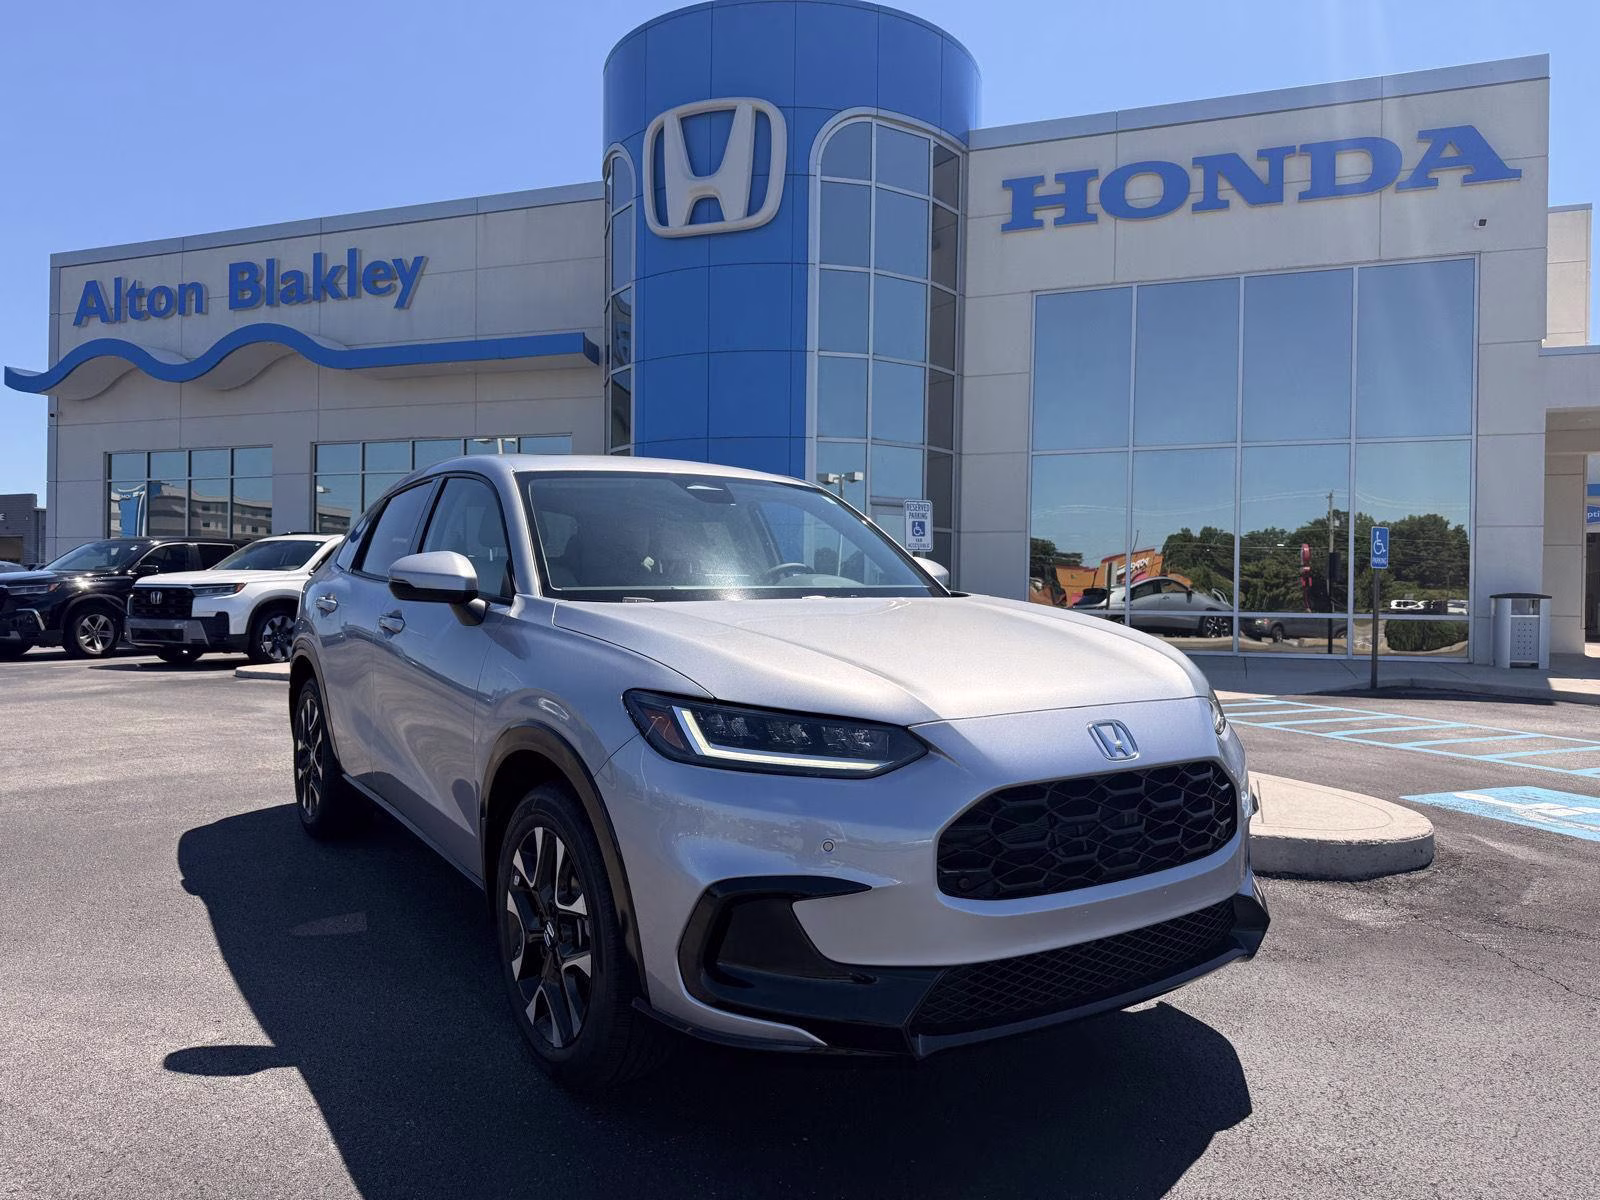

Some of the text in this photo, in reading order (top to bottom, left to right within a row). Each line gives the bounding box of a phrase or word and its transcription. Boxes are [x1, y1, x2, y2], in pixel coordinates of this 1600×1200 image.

[1001, 125, 1522, 233] HONDA
[73, 247, 425, 327] Alton Blakley
[906, 503, 930, 512] RESERVED
